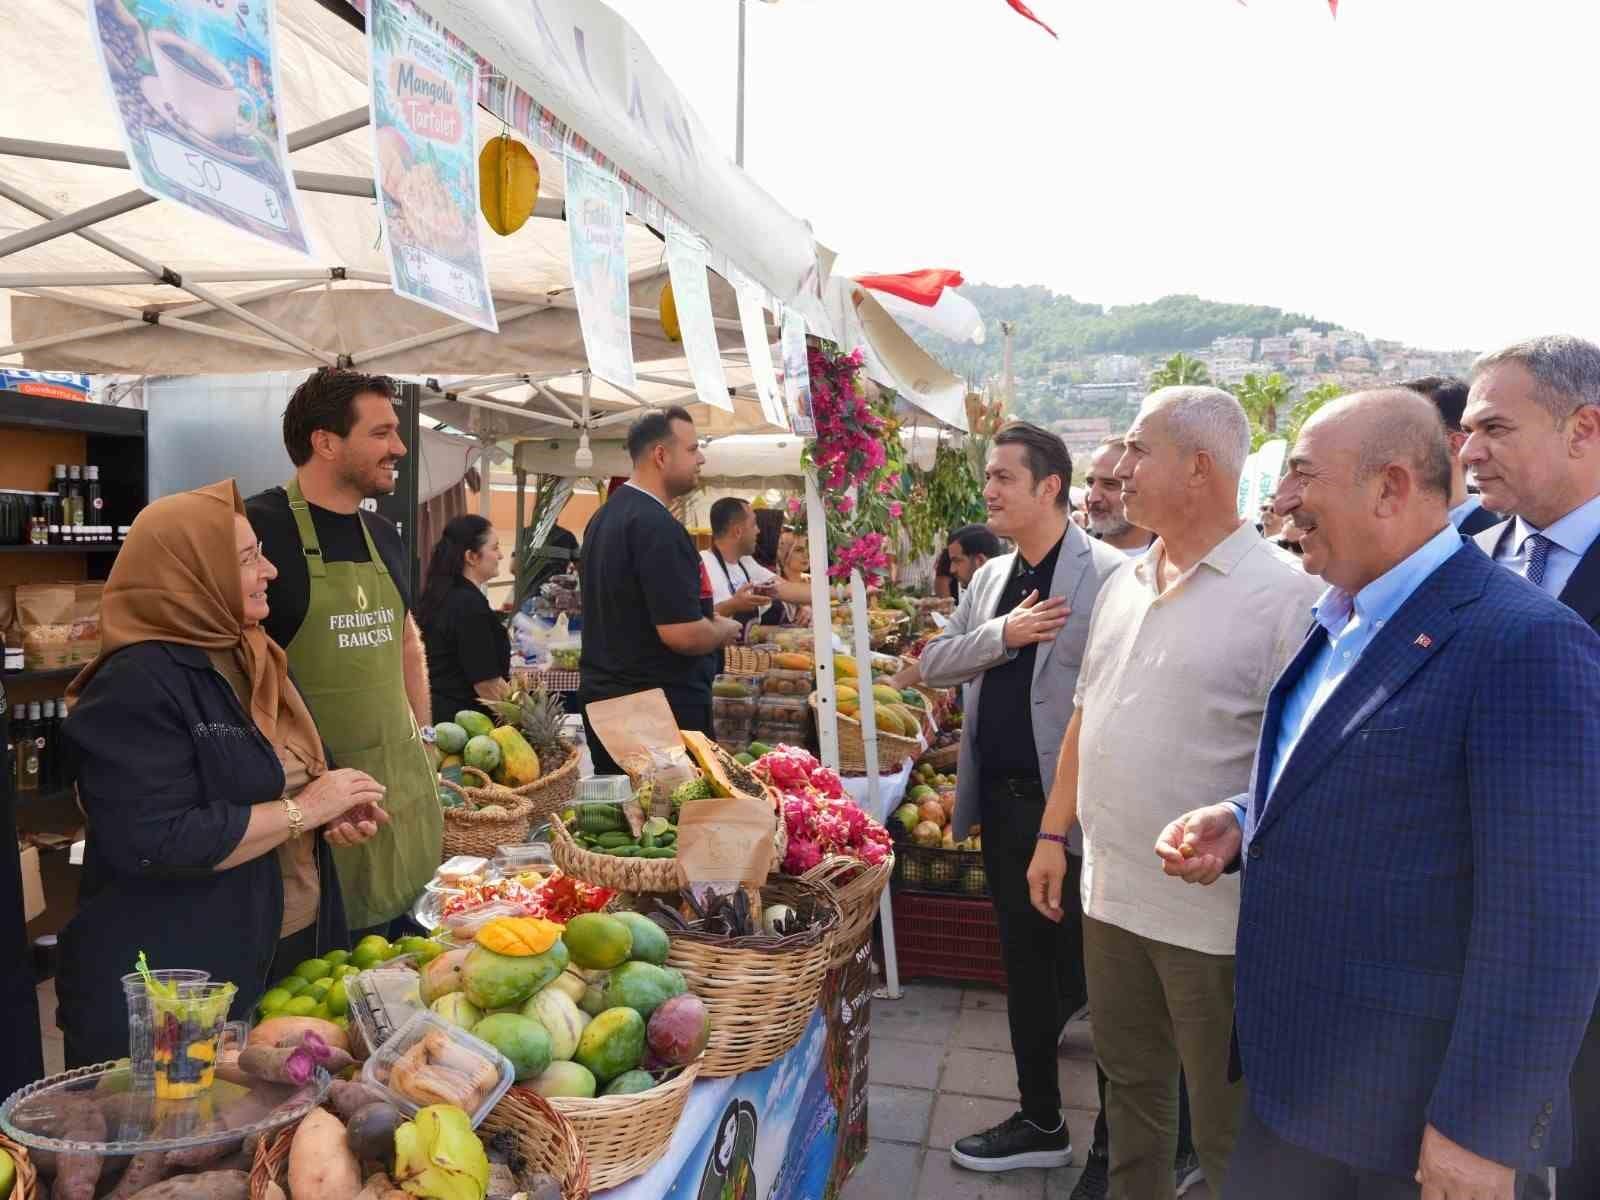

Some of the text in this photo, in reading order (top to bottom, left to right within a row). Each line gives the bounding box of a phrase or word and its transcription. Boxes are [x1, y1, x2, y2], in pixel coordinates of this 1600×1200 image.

[396, 63, 453, 105] Mangolu
[407, 100, 459, 138] Tartolet
[184, 152, 222, 192] 50
